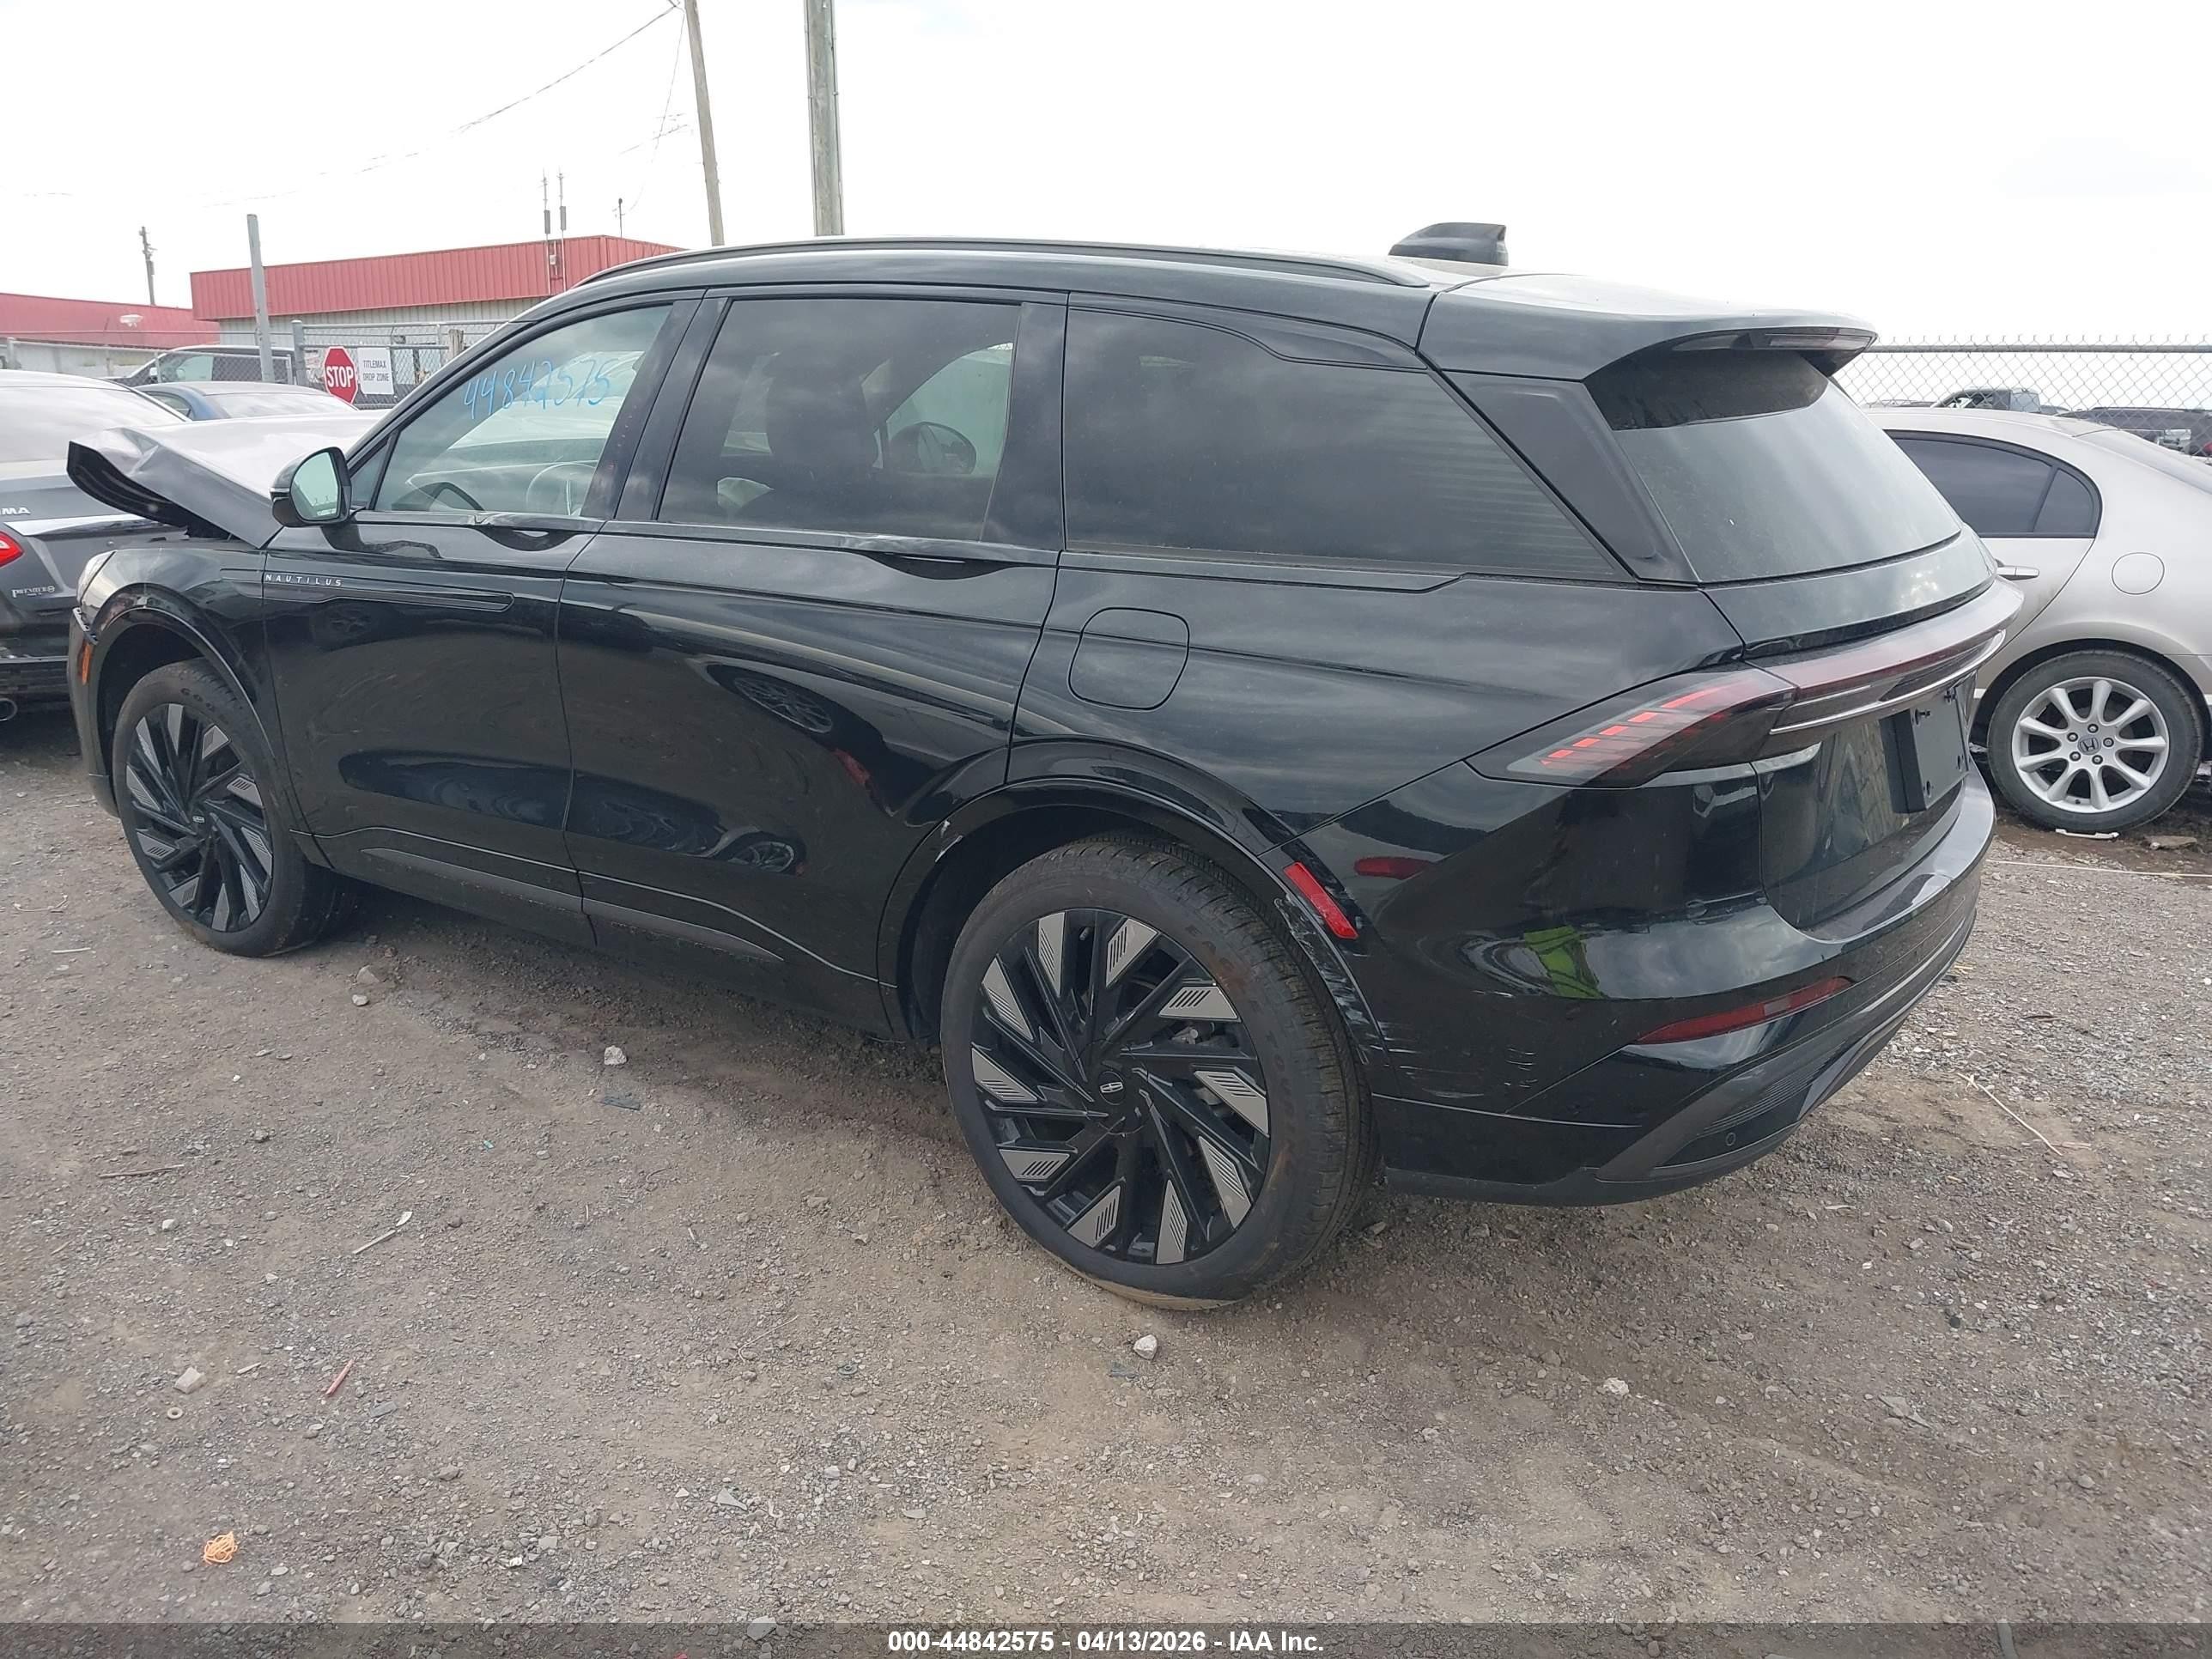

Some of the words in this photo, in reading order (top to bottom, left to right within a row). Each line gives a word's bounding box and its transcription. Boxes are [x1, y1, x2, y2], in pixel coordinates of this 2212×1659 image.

[363, 360, 386, 368] TITLEMAX
[326, 366, 354, 387] STOP
[362, 373, 375, 381] DROP
[376, 373, 390, 381] ZONE
[464, 357, 618, 419] 44842575
[265, 574, 342, 586] NAUTILUS
